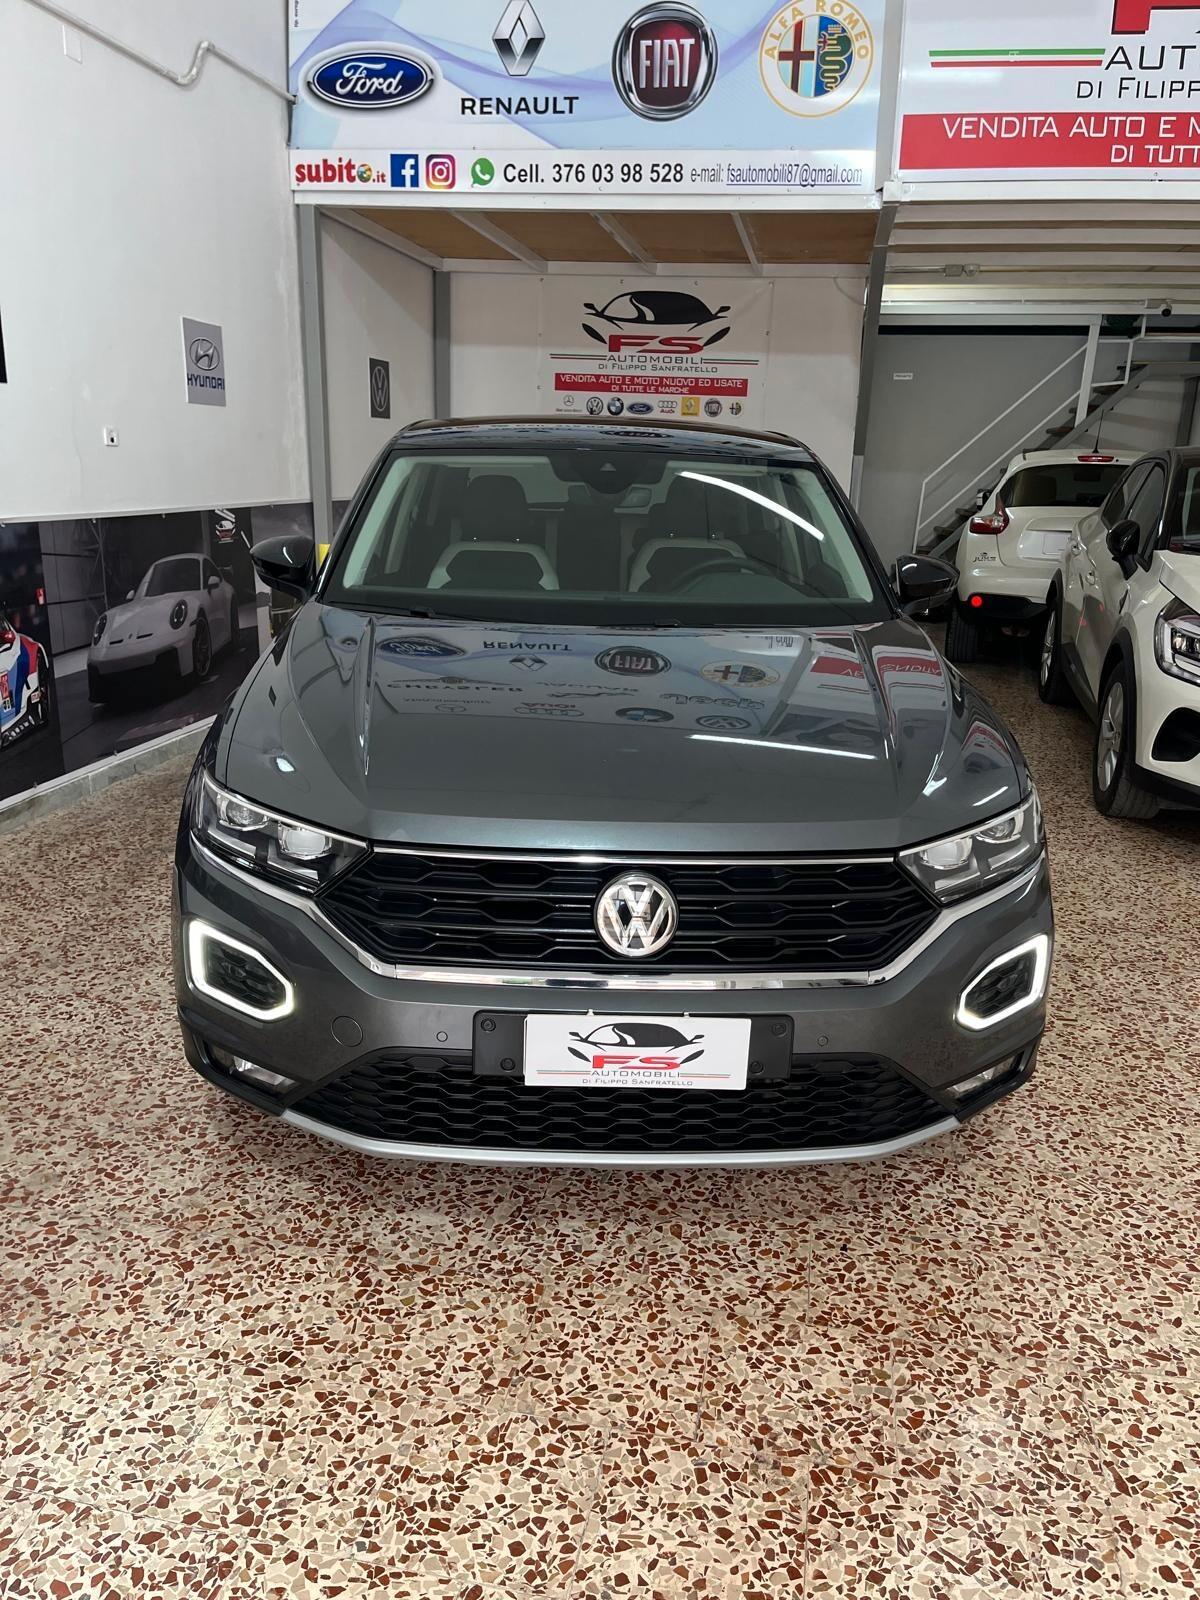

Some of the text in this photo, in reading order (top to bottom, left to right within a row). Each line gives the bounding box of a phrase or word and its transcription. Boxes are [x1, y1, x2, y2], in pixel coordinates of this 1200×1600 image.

[765, 0, 870, 60] ALFA ROMEO
[639, 38, 696, 89] FIAT
[335, 62, 404, 95] Ford
[1077, 80, 1102, 98] DI
[460, 96, 580, 115] RENAULT
[942, 116, 1060, 139] VENDITA
[1069, 116, 1146, 138] AUTO
[1158, 116, 1177, 138] E
[1110, 144, 1134, 163] DI
[503, 163, 863, 187] Cell. 376 03 98 528 e-mail: fsautomobili87@gmail.com
[608, 335, 705, 355] FS
[607, 354, 703, 365] AUTOMOBILI
[611, 363, 647, 371] FILIPPO
[651, 363, 718, 373] SANFRATELLO
[187, 372, 226, 391] HYUNDAI
[560, 374, 743, 388] VENDITA AUTO E MOTO NUOVO ED USATE
[658, 386, 690, 394] MARCHE
[592, 1055, 681, 1071] FS
[591, 1070, 680, 1078] AUTOMOBILI
[631, 1078, 693, 1087] SANFRATELLO
